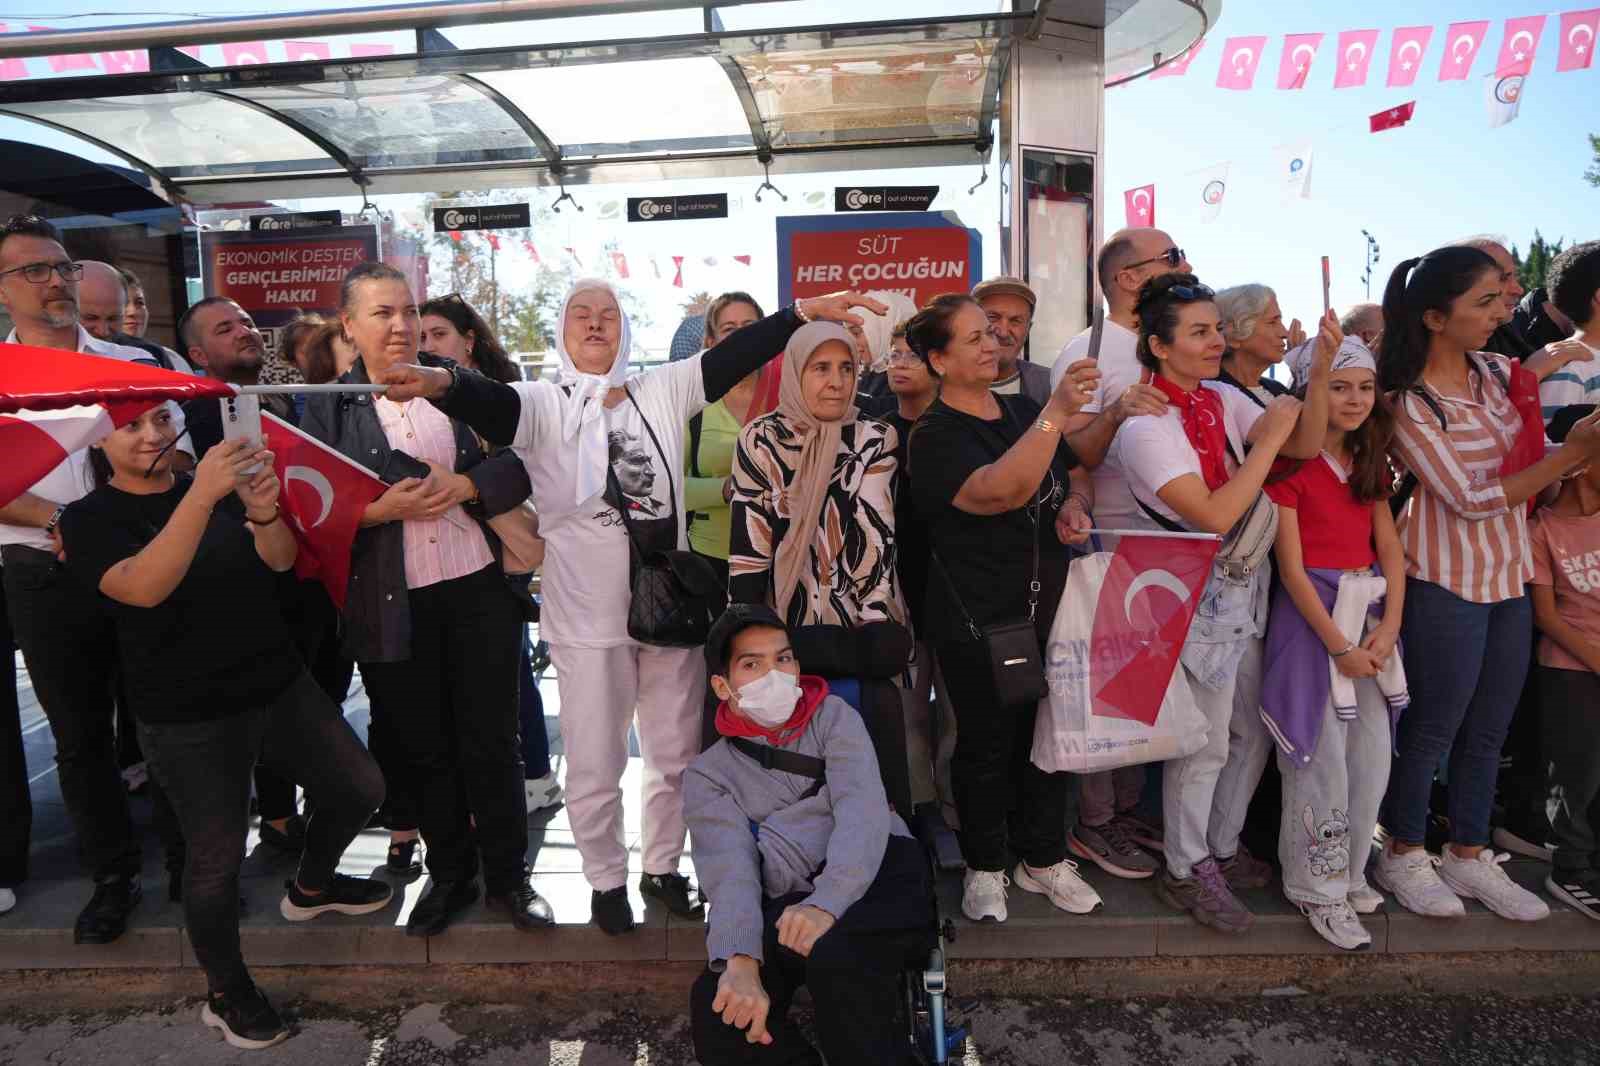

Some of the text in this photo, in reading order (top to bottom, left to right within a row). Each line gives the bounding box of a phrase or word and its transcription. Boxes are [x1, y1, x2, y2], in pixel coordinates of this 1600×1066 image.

[846, 189, 882, 209] Core
[444, 210, 477, 229] Core
[638, 199, 673, 220] Core
[857, 234, 902, 256] SÜT
[215, 247, 363, 266] EKONOMİK DESTEK
[796, 257, 965, 286] HER ÇOCUĞUN
[265, 289, 316, 304] HAKKI
